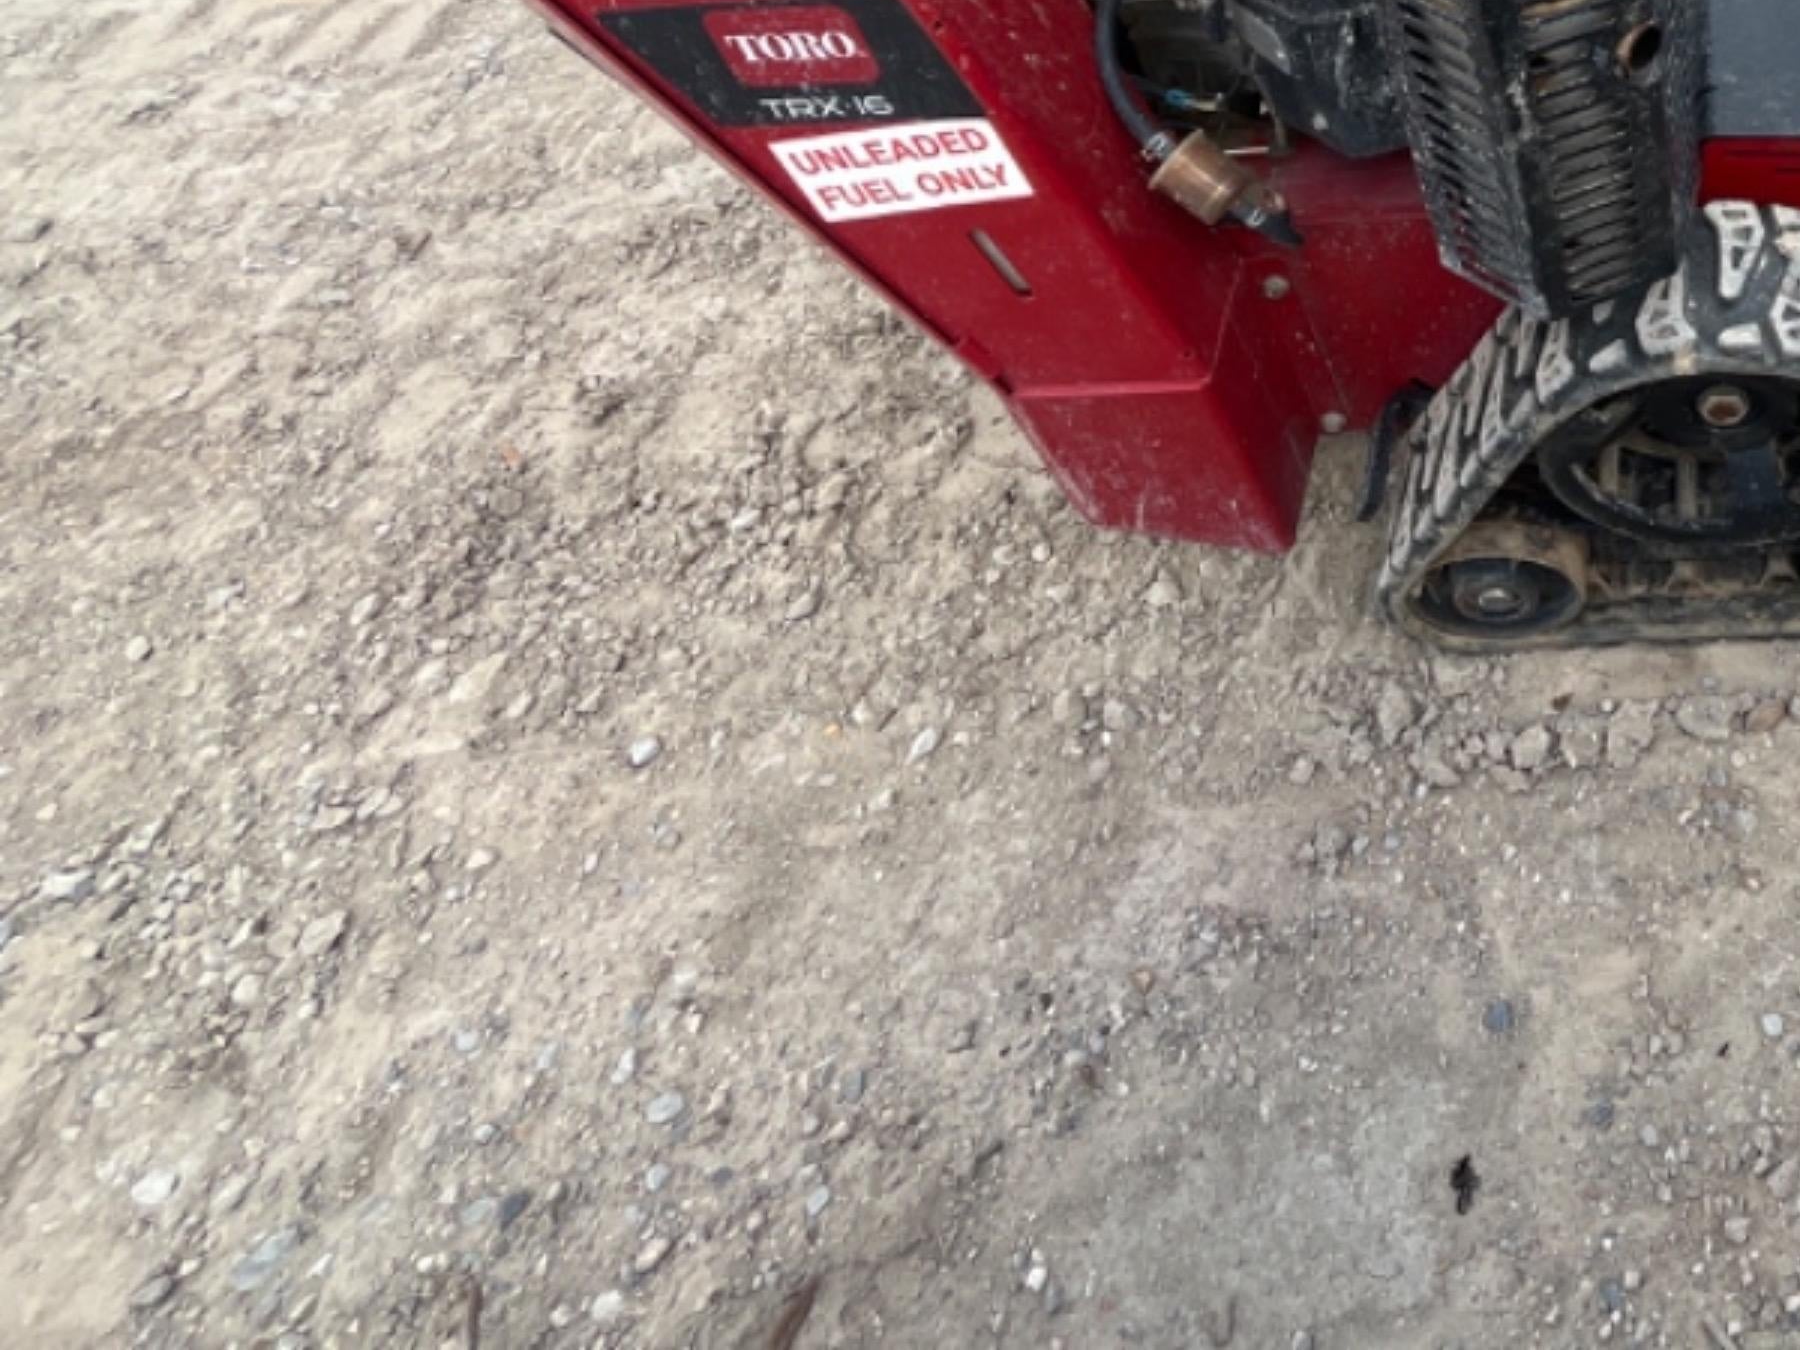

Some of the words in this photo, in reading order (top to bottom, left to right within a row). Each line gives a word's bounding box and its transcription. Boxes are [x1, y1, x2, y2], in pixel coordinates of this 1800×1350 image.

[725, 31, 857, 62] TORO
[789, 128, 990, 176] UNLEADED
[816, 177, 914, 211] FUEL
[915, 163, 1010, 197] ONLY
